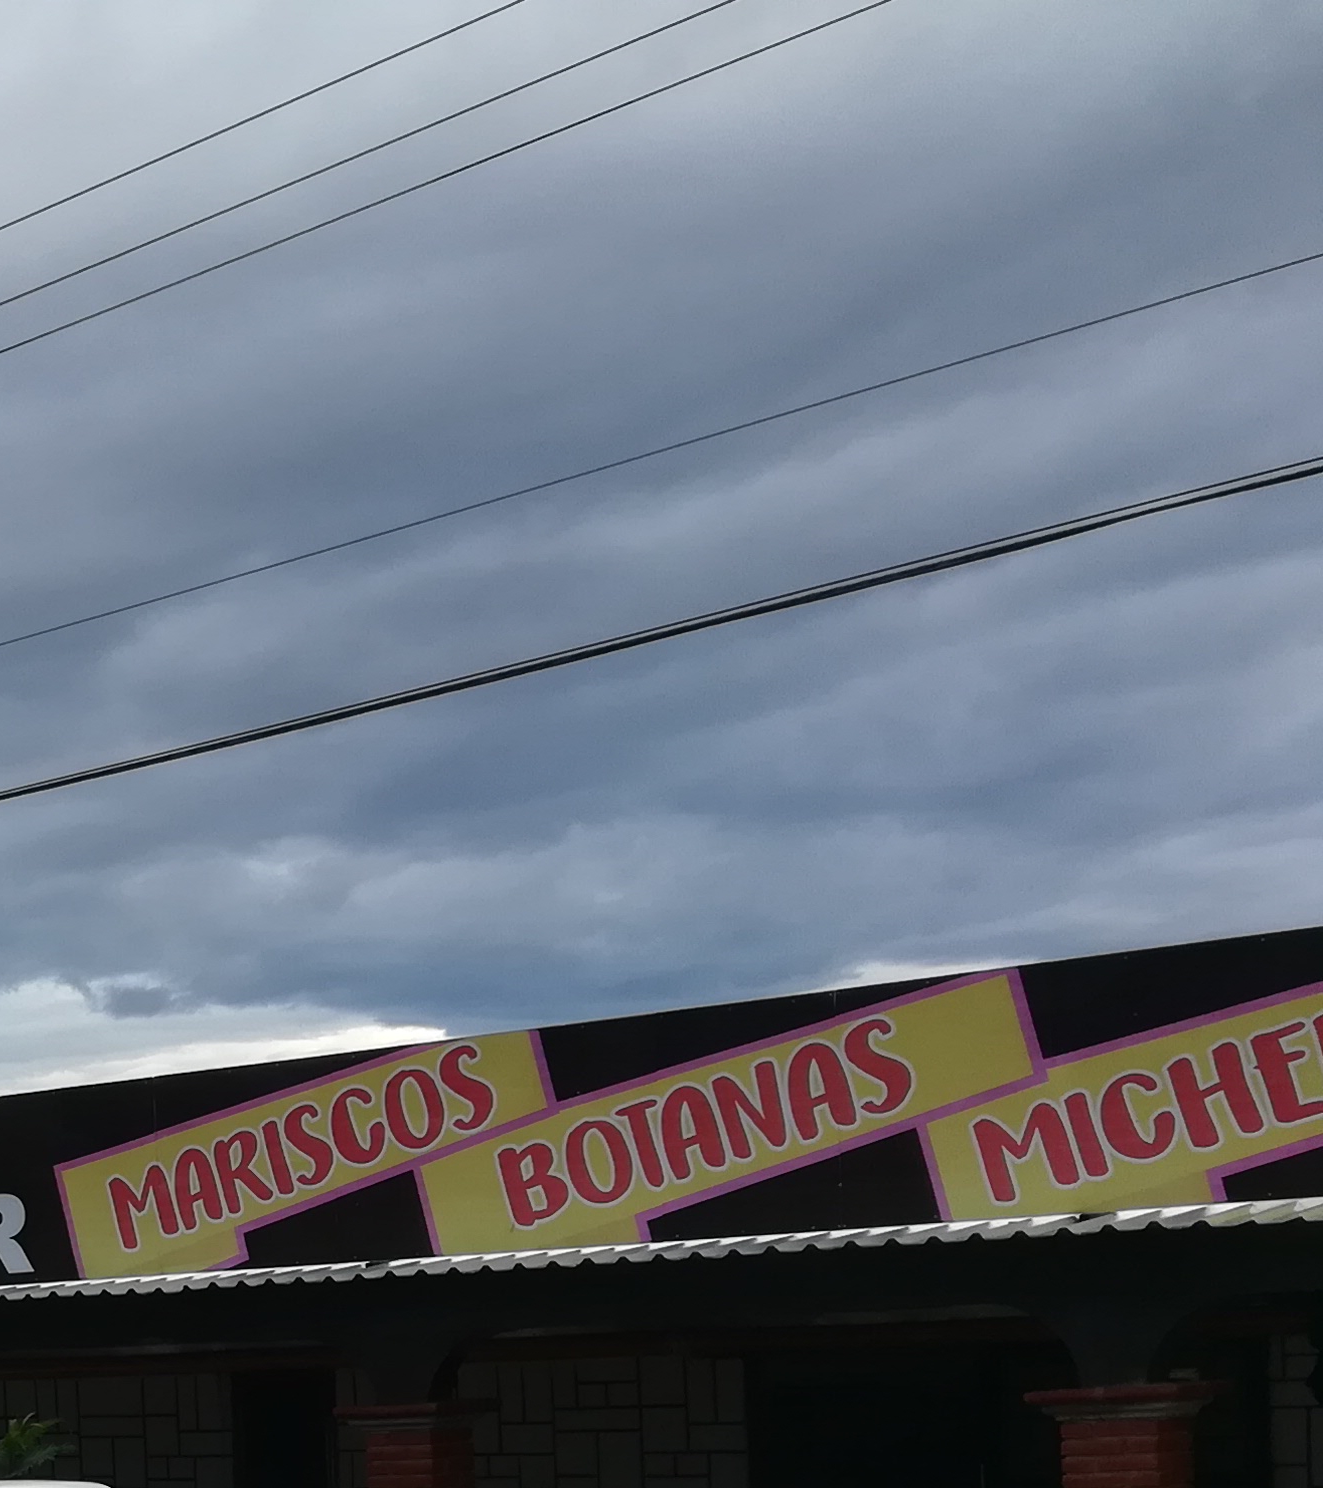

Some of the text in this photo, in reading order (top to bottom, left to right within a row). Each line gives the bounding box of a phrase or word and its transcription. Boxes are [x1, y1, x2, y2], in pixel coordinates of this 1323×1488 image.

[107, 1012, 1323, 1250] MARISCOS BOTANAS MICHE
